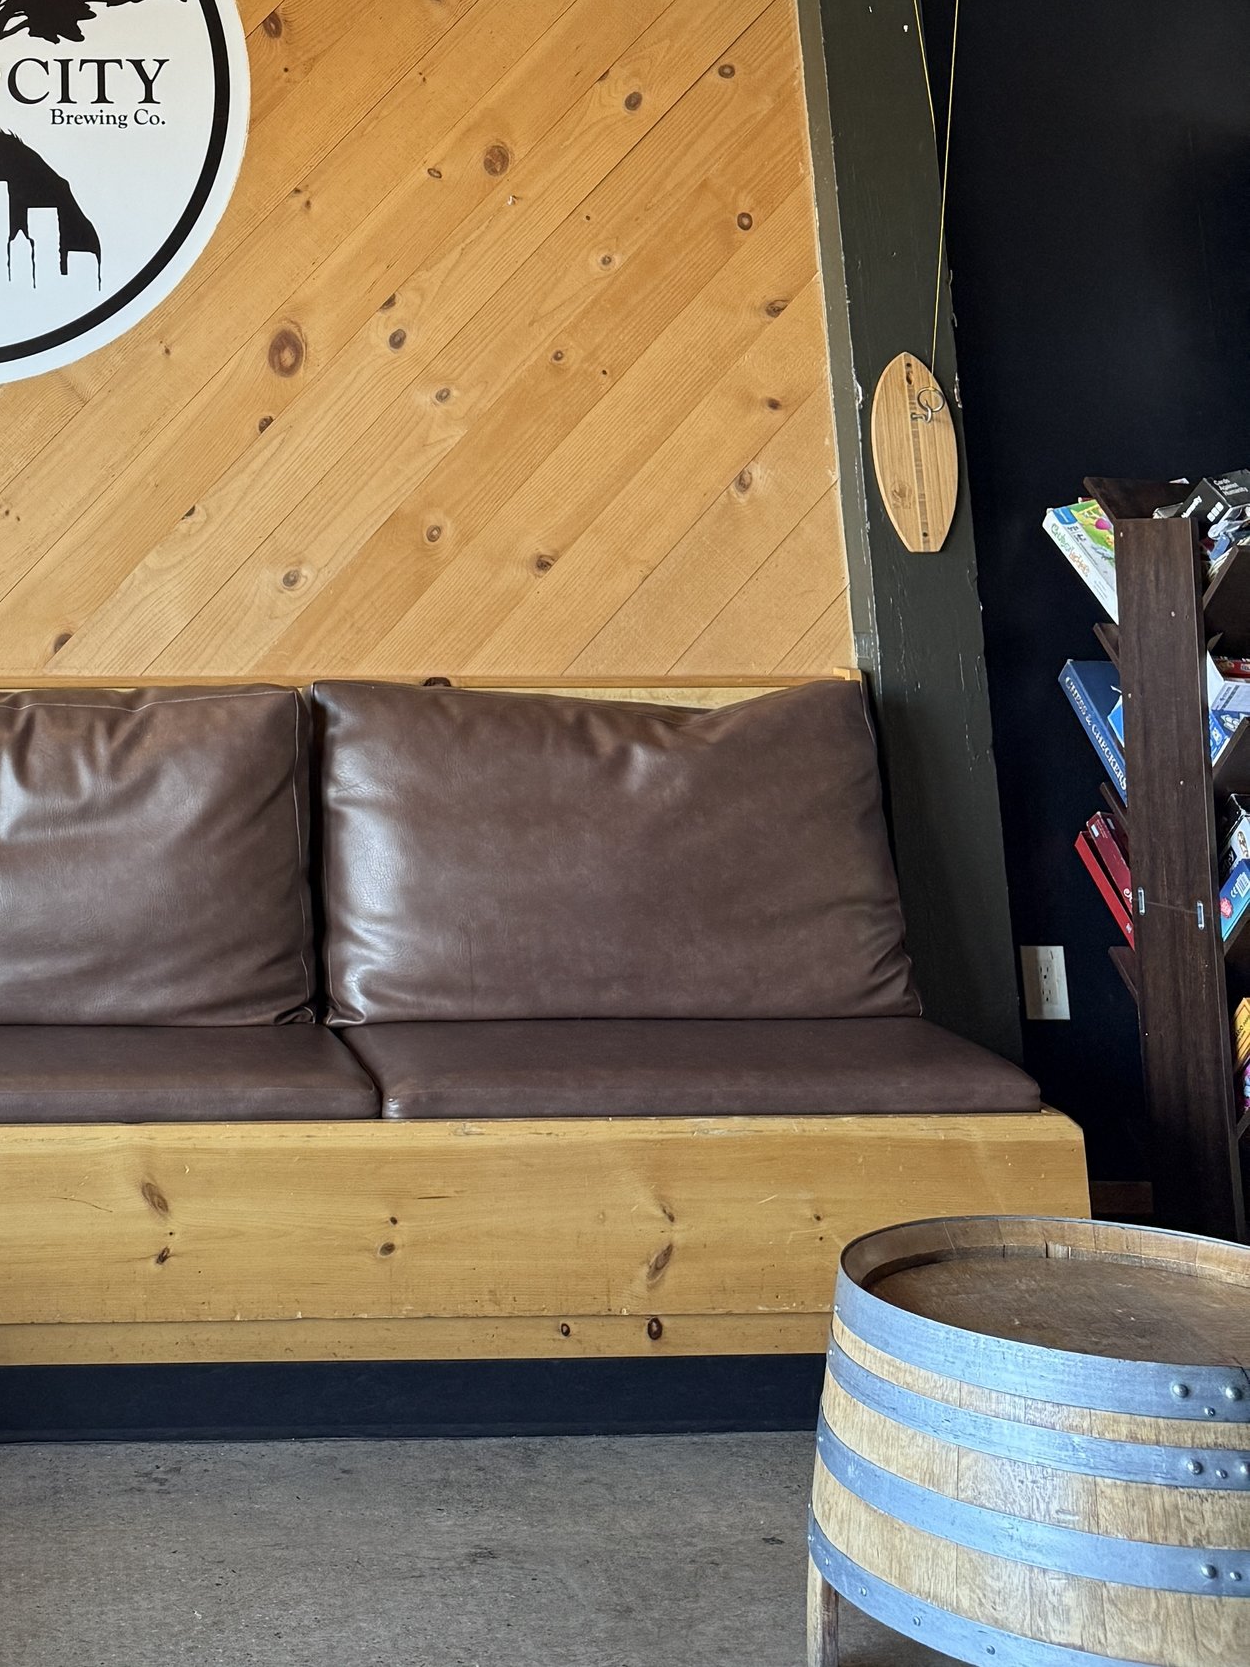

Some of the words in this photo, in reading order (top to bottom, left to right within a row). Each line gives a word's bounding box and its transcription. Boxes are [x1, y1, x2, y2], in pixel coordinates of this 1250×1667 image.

[7, 57, 170, 105] CITY
[50, 108, 128, 129] Brewing
[133, 108, 166, 126] Co.
[1065, 676, 1087, 715] CHESS
[1085, 714, 1092, 726] &
[1091, 723, 1127, 791] CHECKERS
